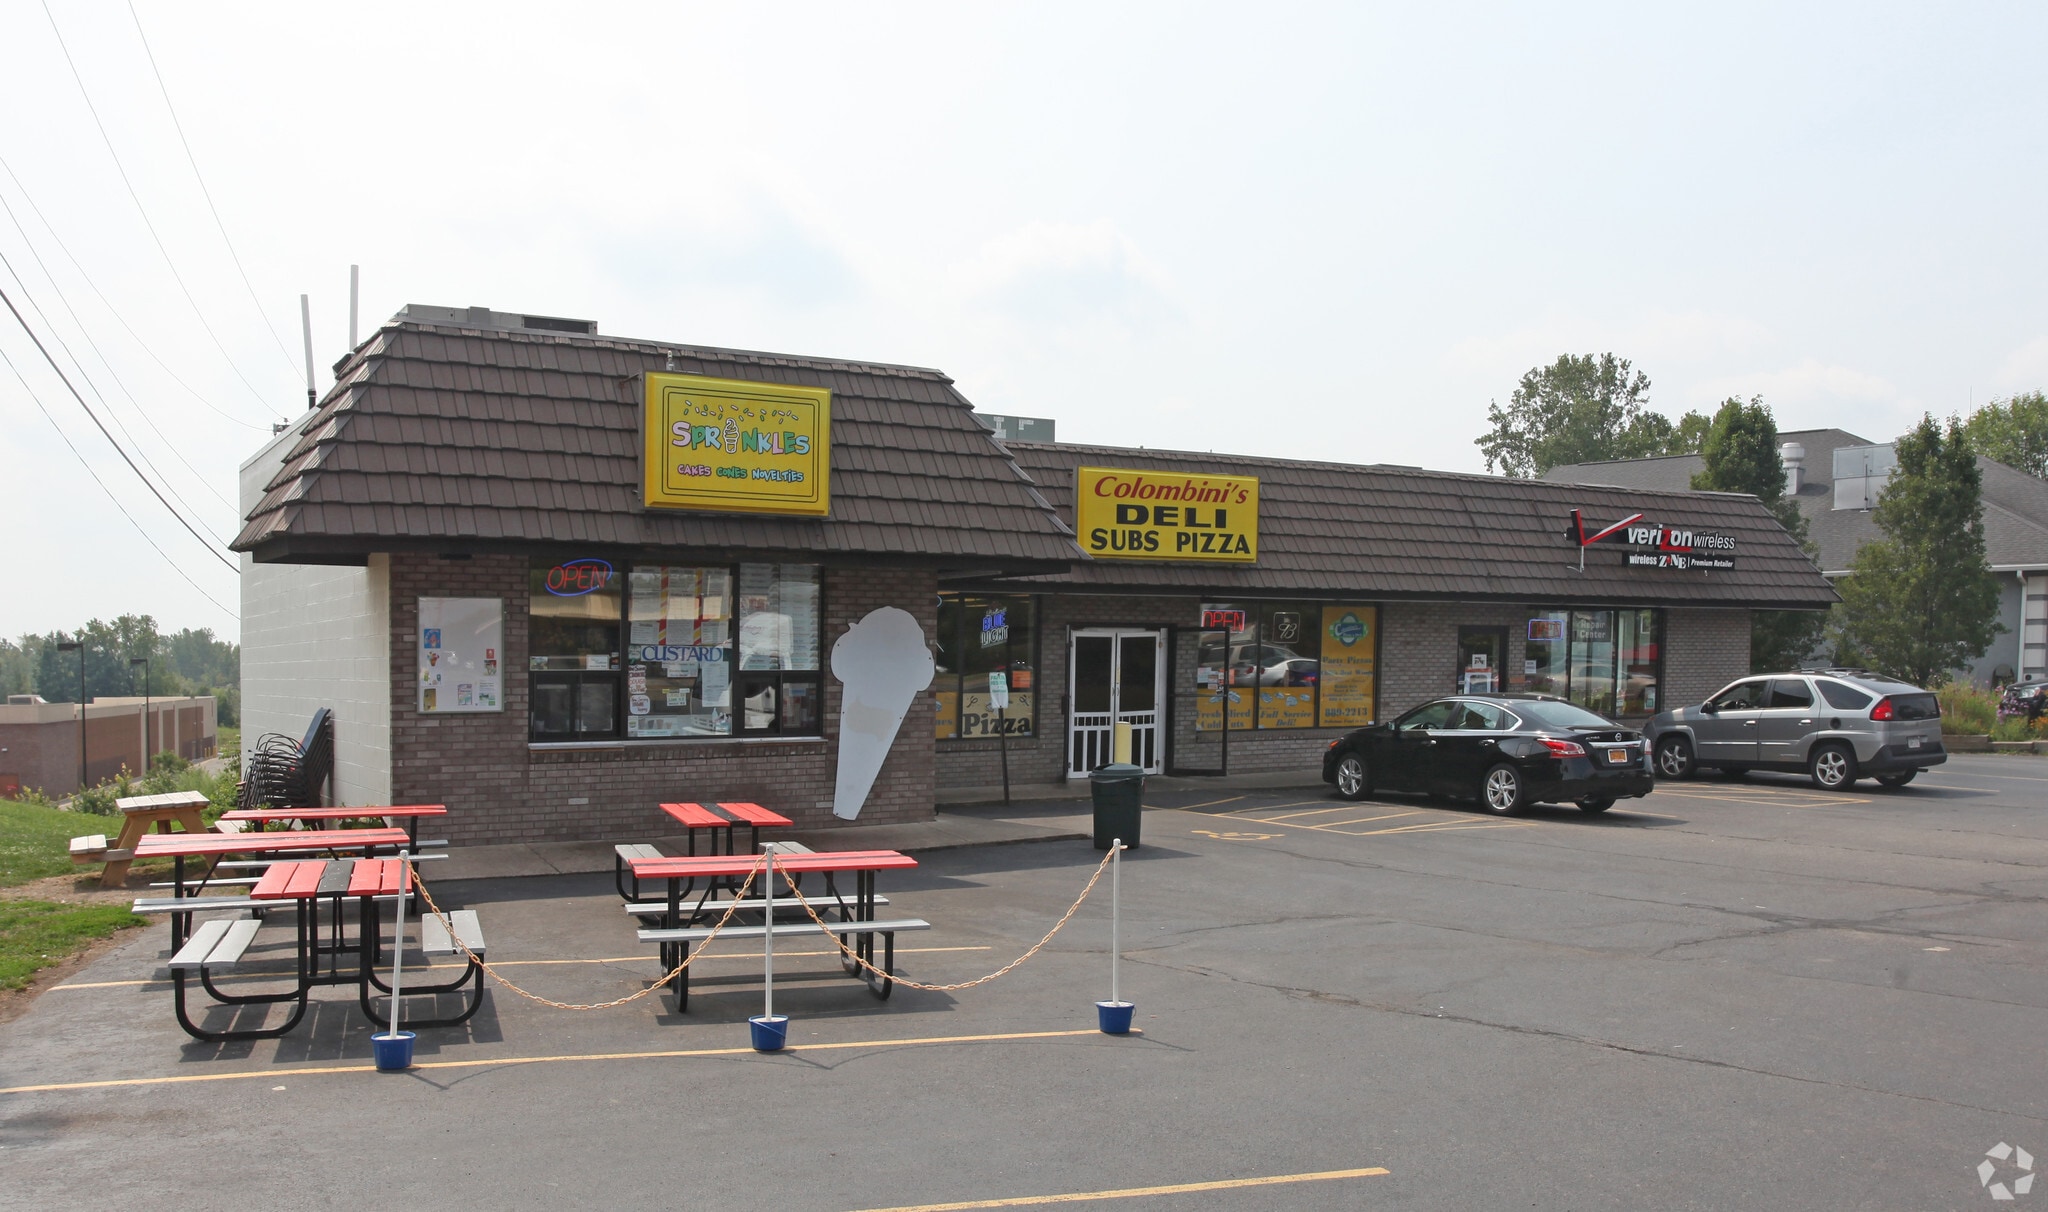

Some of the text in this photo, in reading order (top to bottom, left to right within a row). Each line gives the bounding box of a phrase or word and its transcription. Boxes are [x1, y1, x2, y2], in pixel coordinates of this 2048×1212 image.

[672, 418, 810, 455] SPRINKLES
[677, 464, 804, 483] CAKES CONES NOVELTIES
[1094, 476, 1249, 504] Colombini's
[1116, 504, 1227, 529] DELI
[1091, 528, 1251, 554] SUBS PIZZA
[1627, 524, 1735, 552] verizon wireless
[1629, 554, 1657, 565] wireless
[1691, 558, 1713, 567] Premium
[1713, 560, 1734, 568] Retailer
[547, 566, 607, 590] OPEN
[983, 612, 1006, 632] BLUE
[1203, 611, 1244, 632] OPEN
[1581, 619, 1606, 630] Repair
[981, 625, 1009, 646] LIGHT
[1580, 630, 1606, 639] Center
[642, 646, 723, 662] CUSTARD
[962, 713, 1031, 736] Pizza
